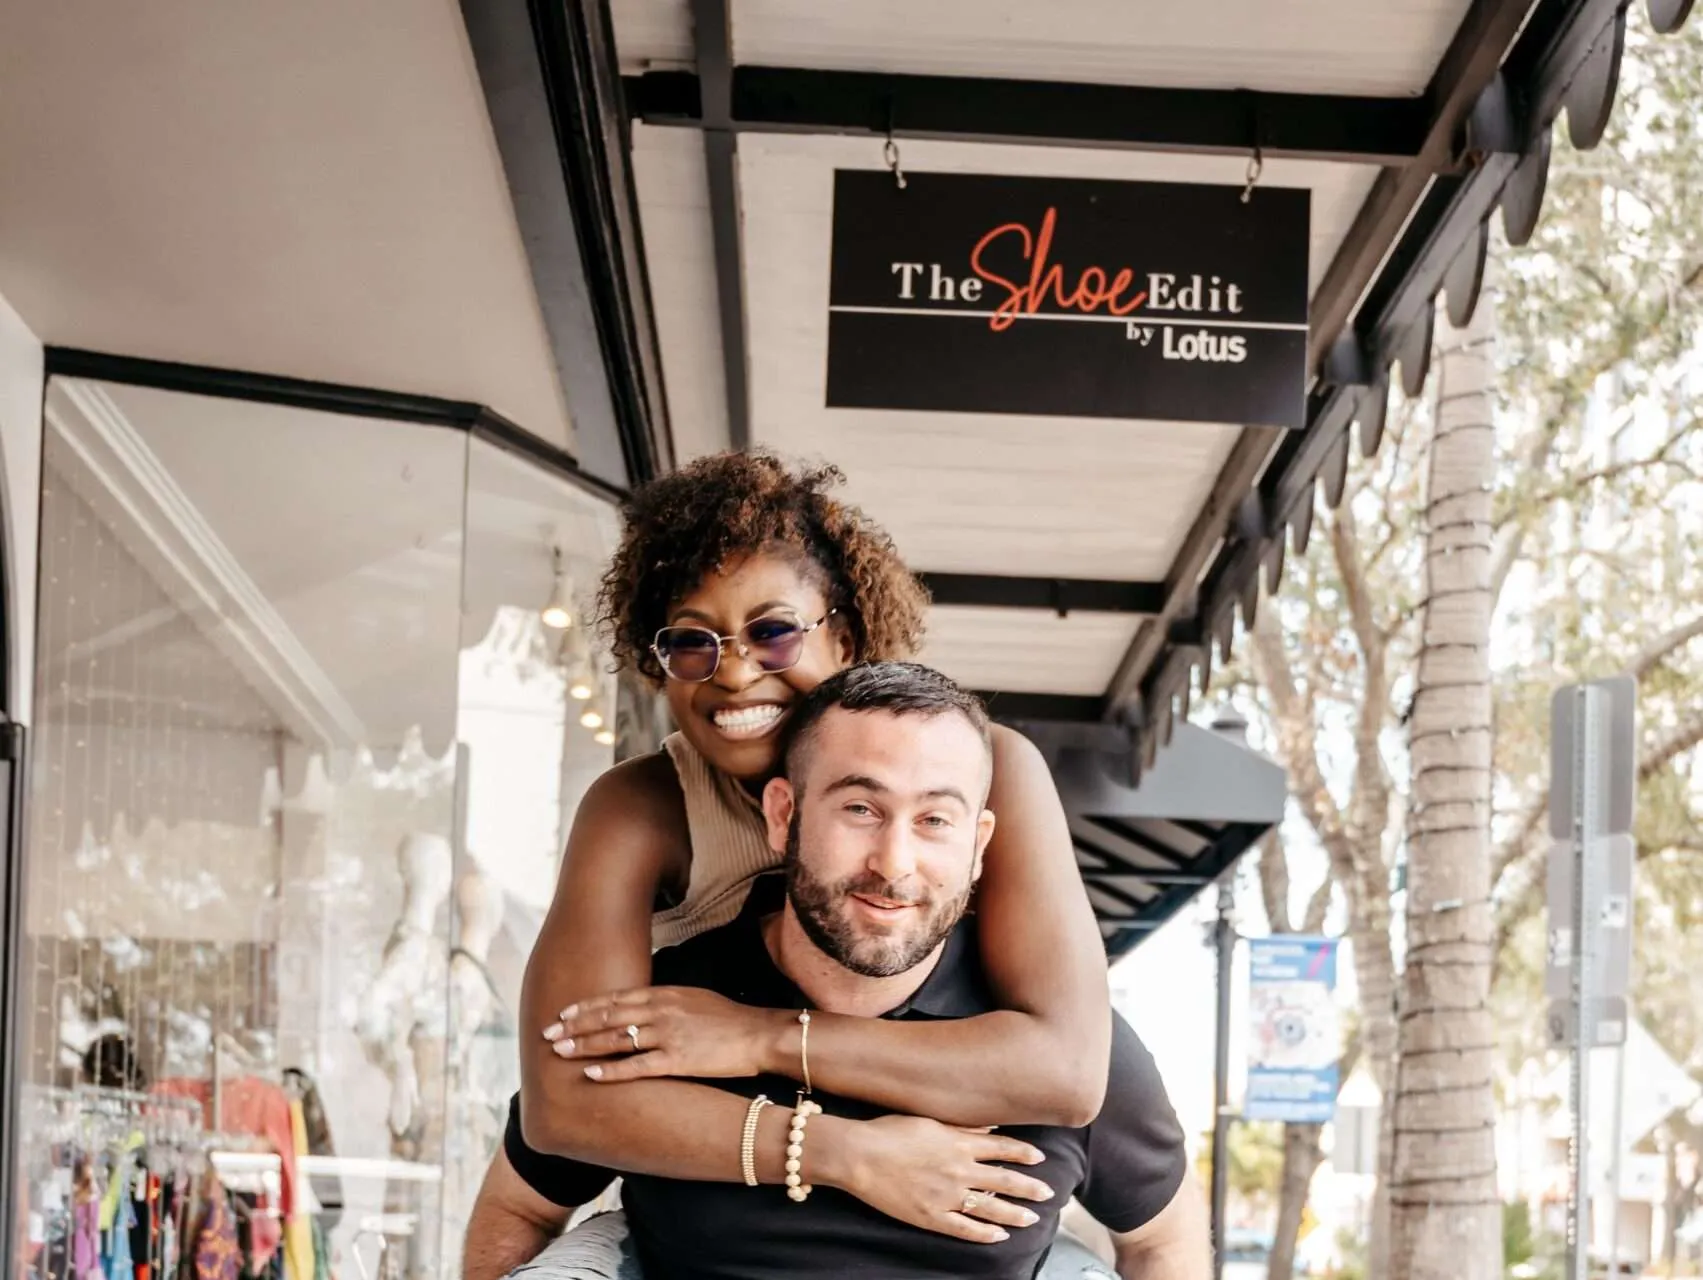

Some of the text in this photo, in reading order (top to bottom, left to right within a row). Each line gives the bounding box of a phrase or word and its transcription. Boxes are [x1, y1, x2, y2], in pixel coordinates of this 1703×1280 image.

[893, 207, 1243, 330] The Shoe Edit
[1127, 322, 1246, 362] by Lotus
